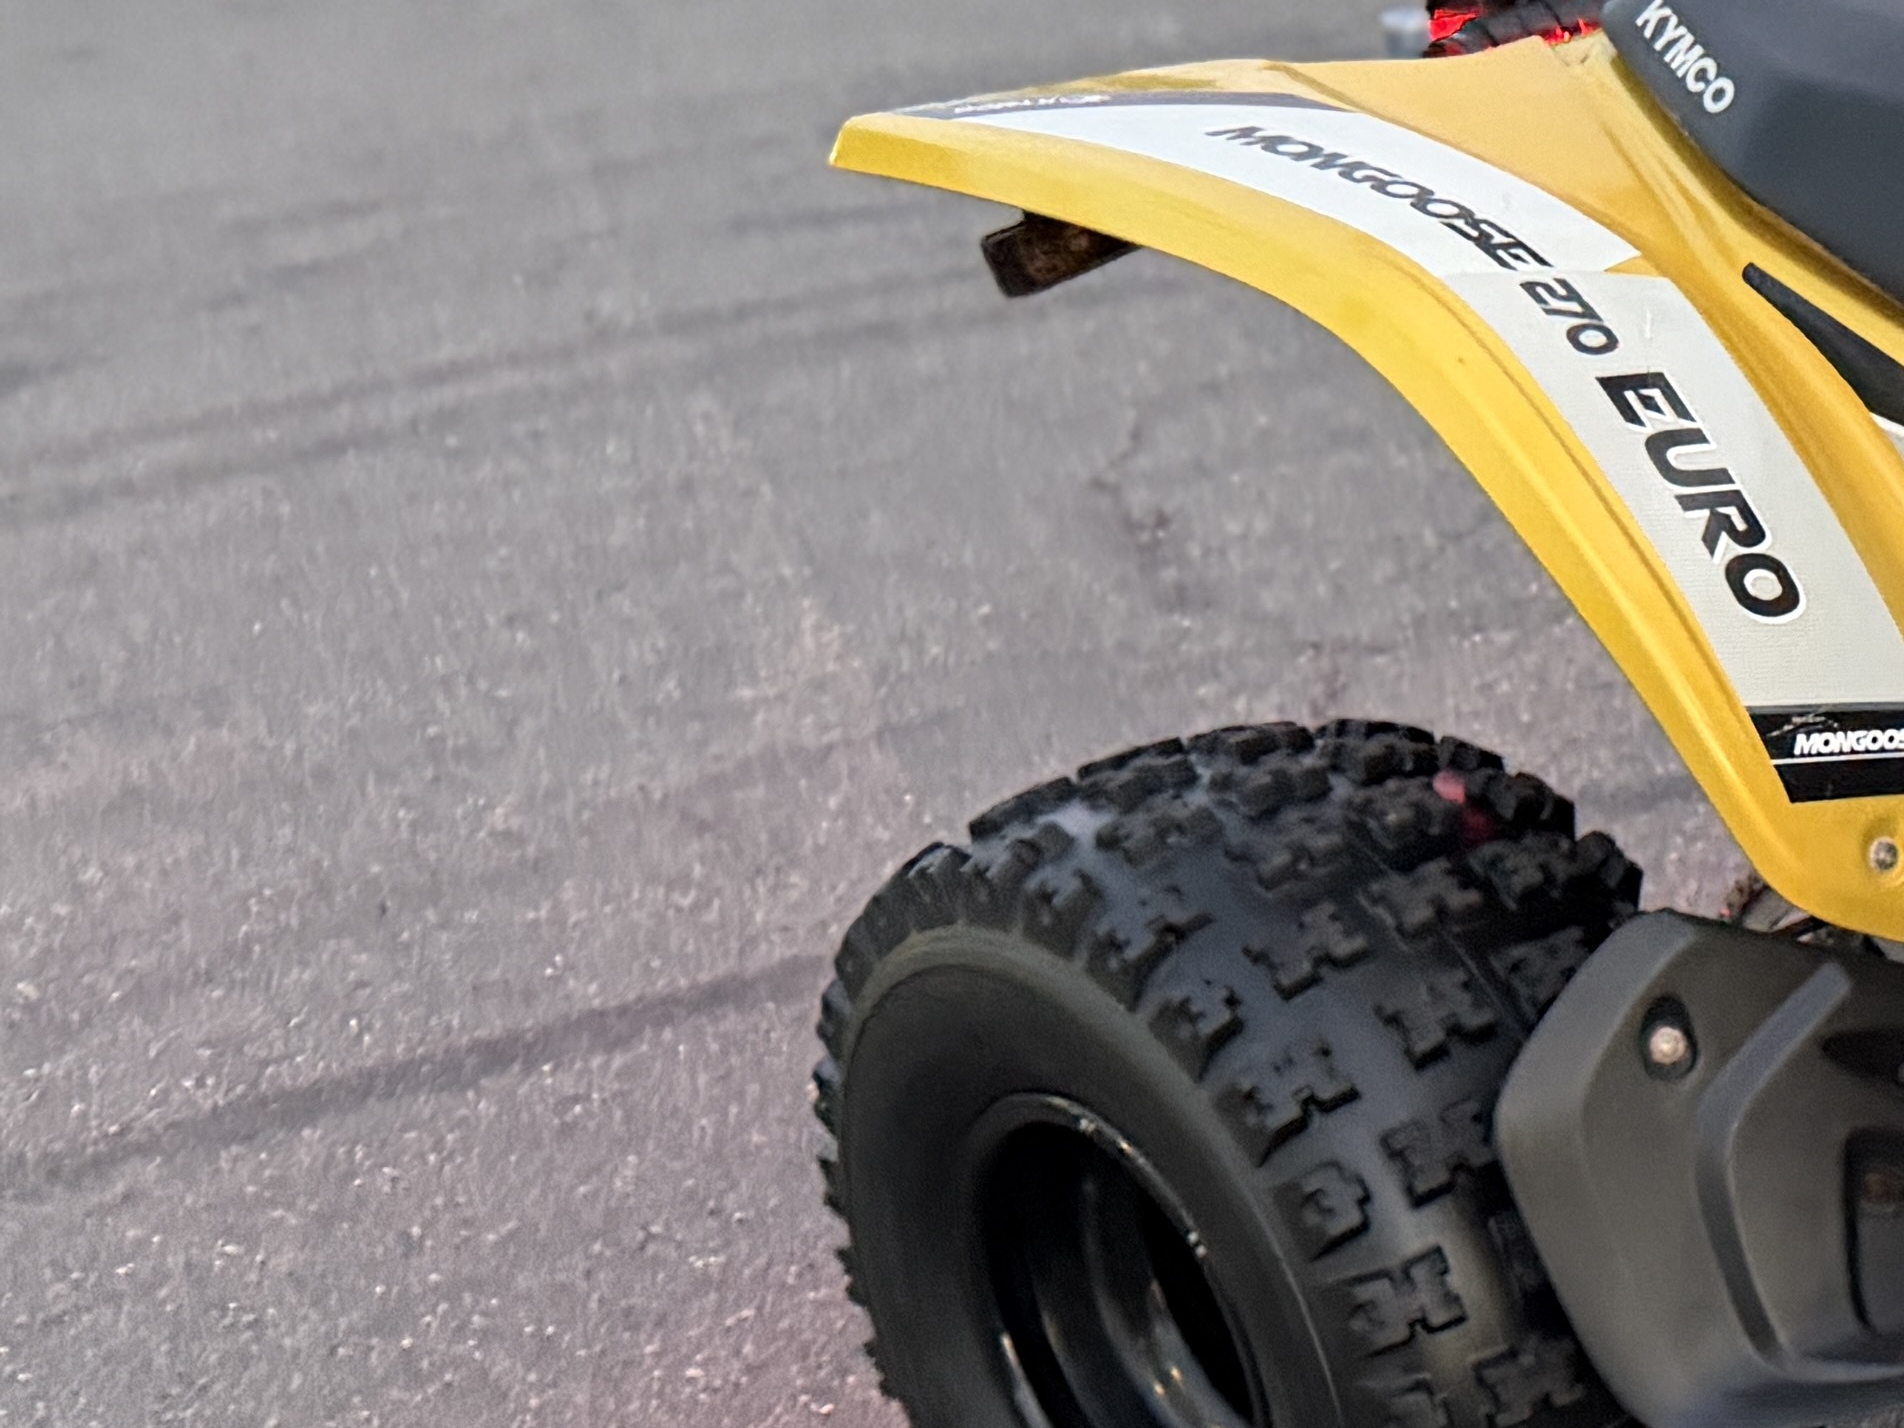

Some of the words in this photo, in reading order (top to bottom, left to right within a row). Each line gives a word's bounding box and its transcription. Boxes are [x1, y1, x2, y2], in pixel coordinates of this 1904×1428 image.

[1205, 125, 1554, 272] MONGOOSE
[1519, 277, 1620, 355] 270
[1595, 371, 1804, 622] EURO
